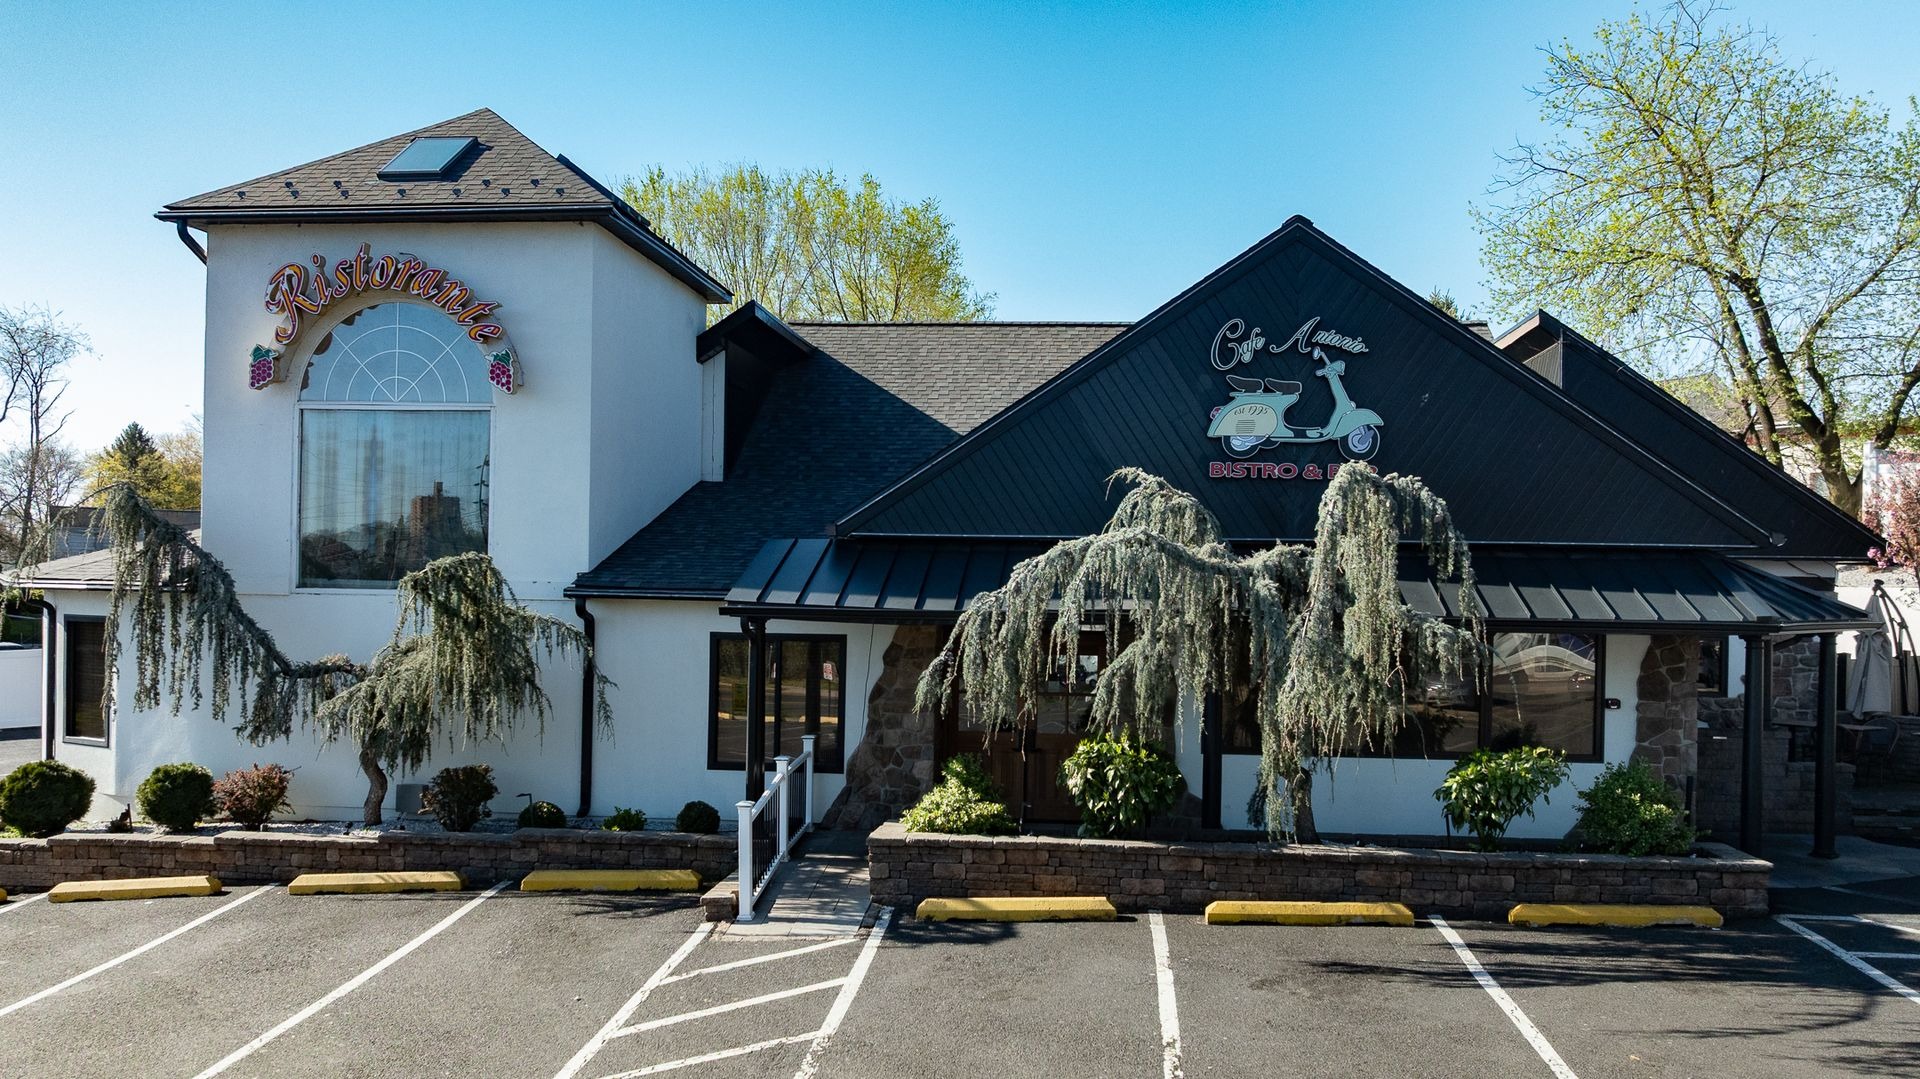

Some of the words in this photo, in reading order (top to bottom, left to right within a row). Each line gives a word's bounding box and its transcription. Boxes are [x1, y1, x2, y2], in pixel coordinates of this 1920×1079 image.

[265, 242, 503, 344] Ristorante
[1210, 318, 1265, 371] Cafe
[1269, 316, 1369, 354] Antonio
[1248, 405, 1269, 416] 1995
[1209, 462, 1298, 479] BISTRO
[1302, 463, 1323, 480] &
